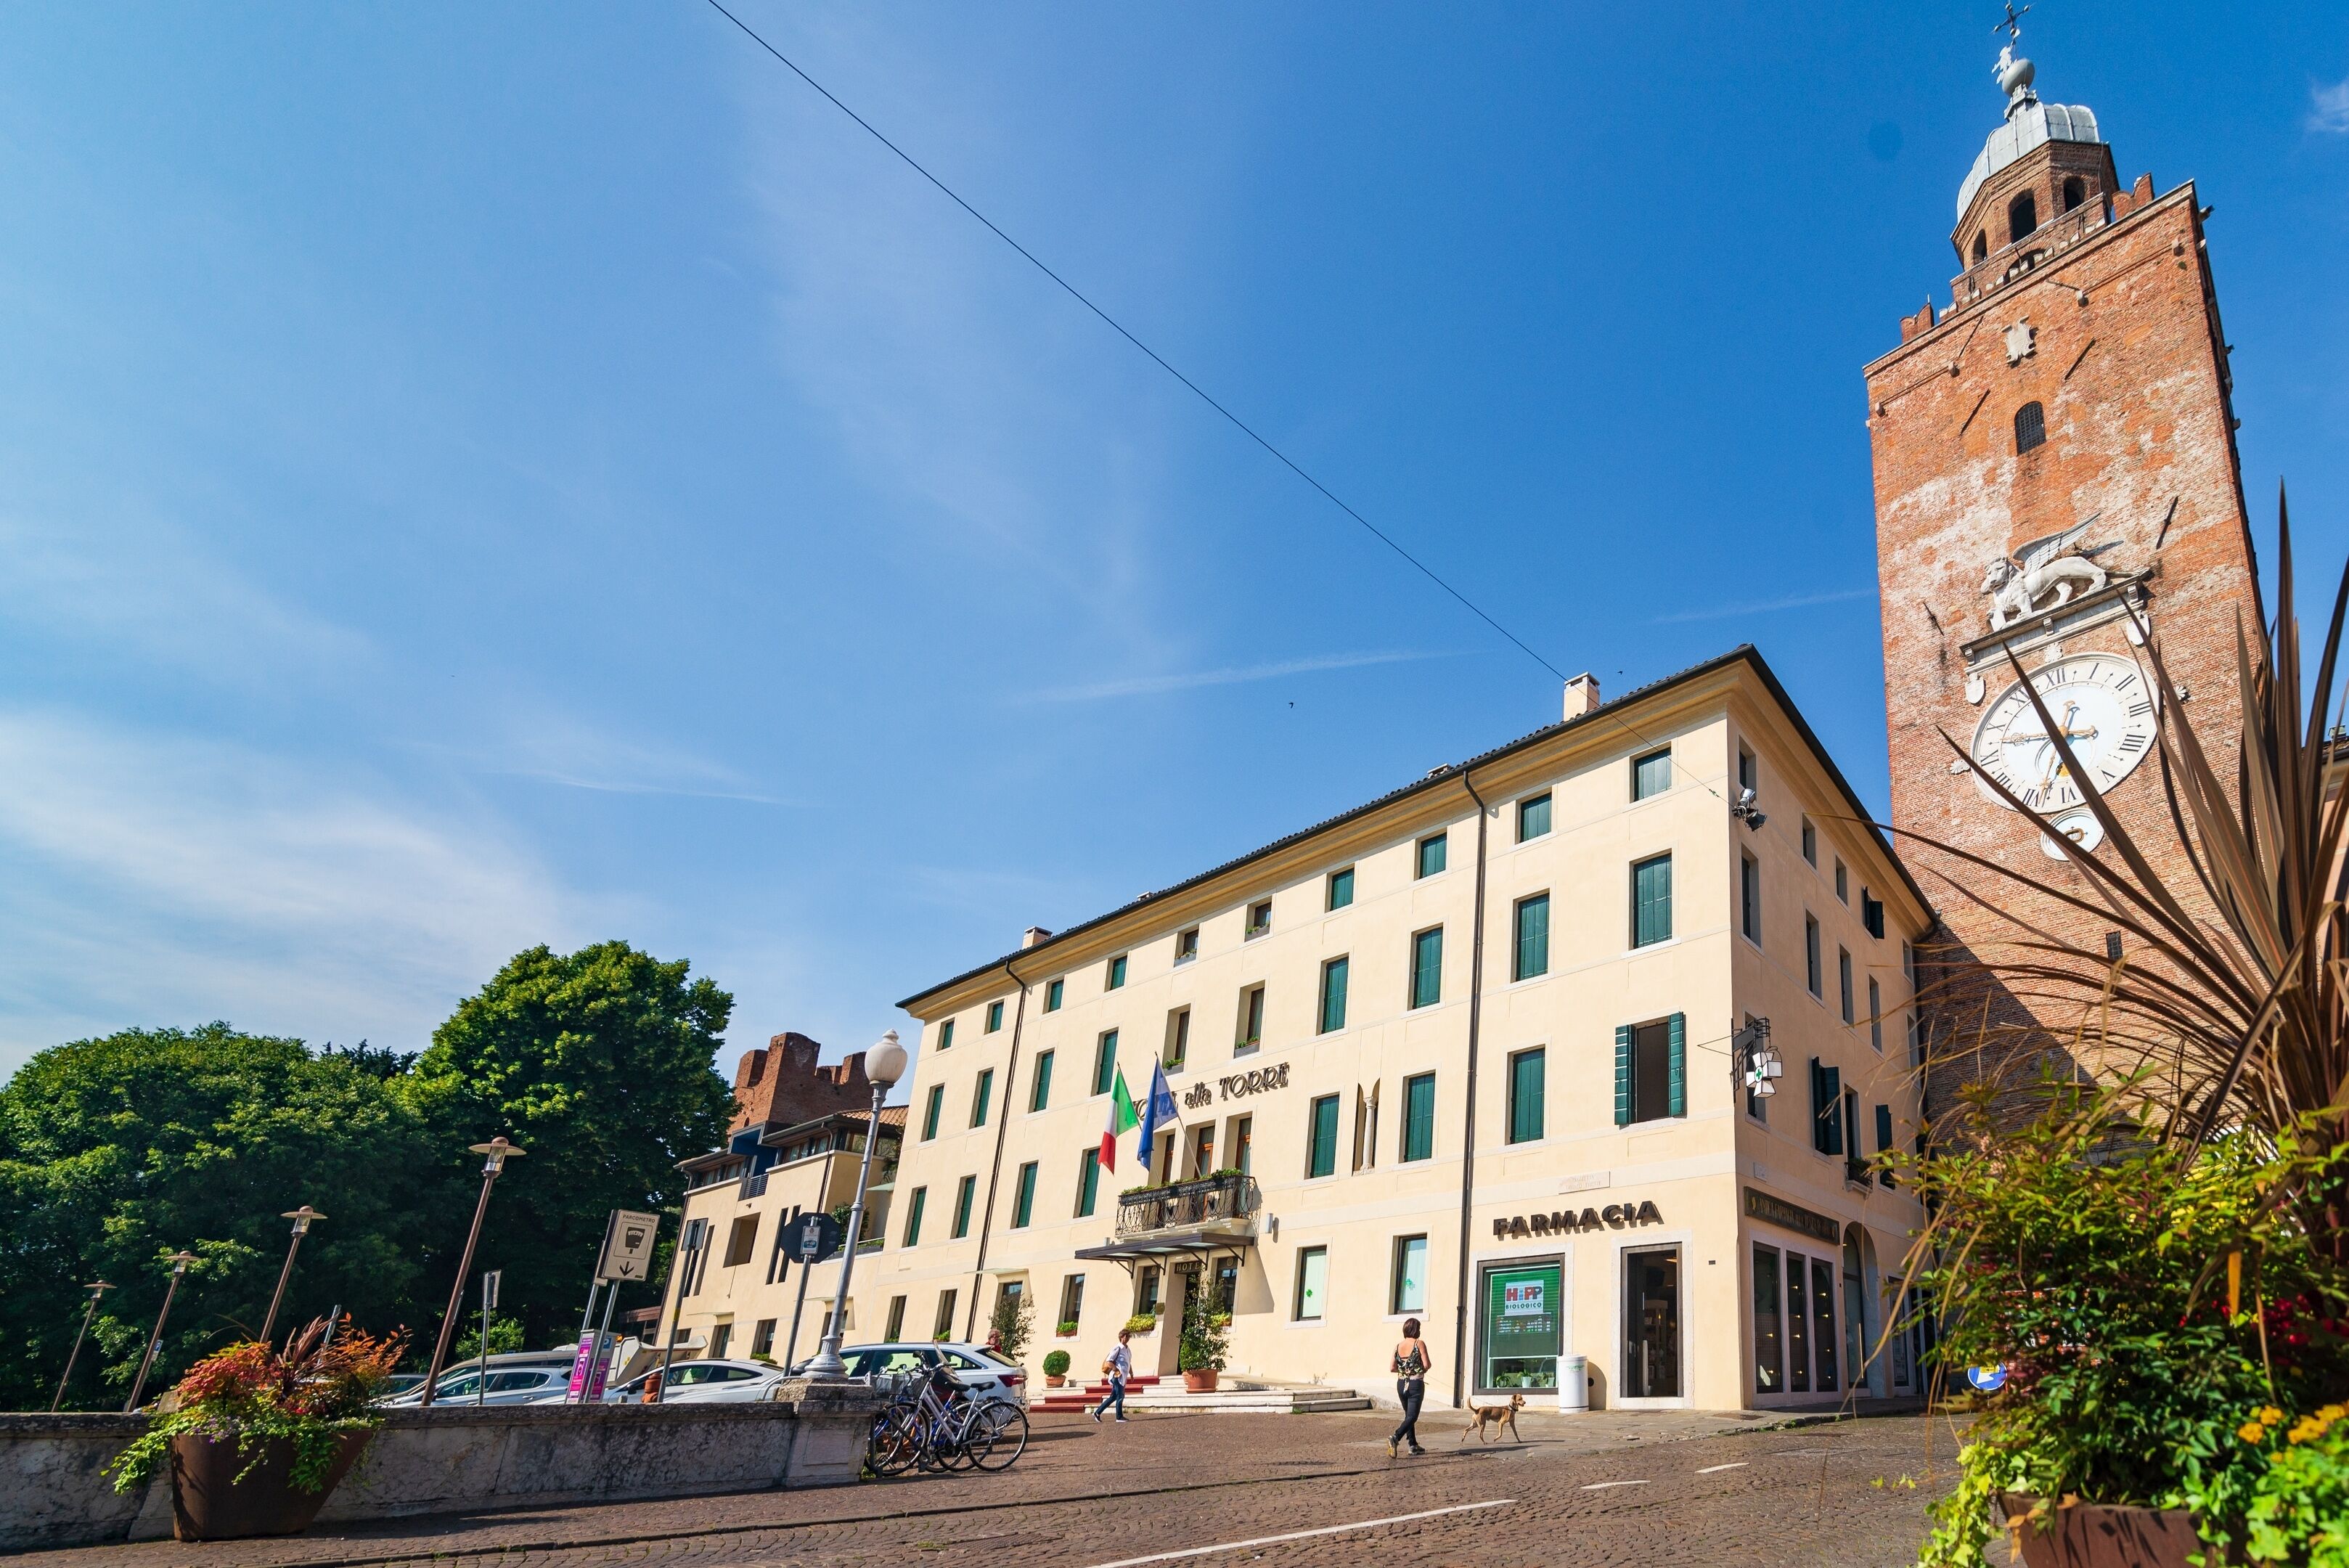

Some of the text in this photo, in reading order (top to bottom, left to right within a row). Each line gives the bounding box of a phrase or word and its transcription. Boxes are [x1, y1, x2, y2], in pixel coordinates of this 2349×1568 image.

[2046, 667, 2066, 689] XII
[2115, 674, 2137, 691] II
[2129, 701, 2152, 717] III
[2120, 733, 2146, 753] IIII
[1185, 1082, 1212, 1108] alla
[1220, 1062, 1289, 1100] TORRE
[623, 1214, 655, 1223] PARCOMETRO
[1493, 1201, 1662, 1237] FARMACIA
[1177, 1262, 1203, 1272] HOTE
